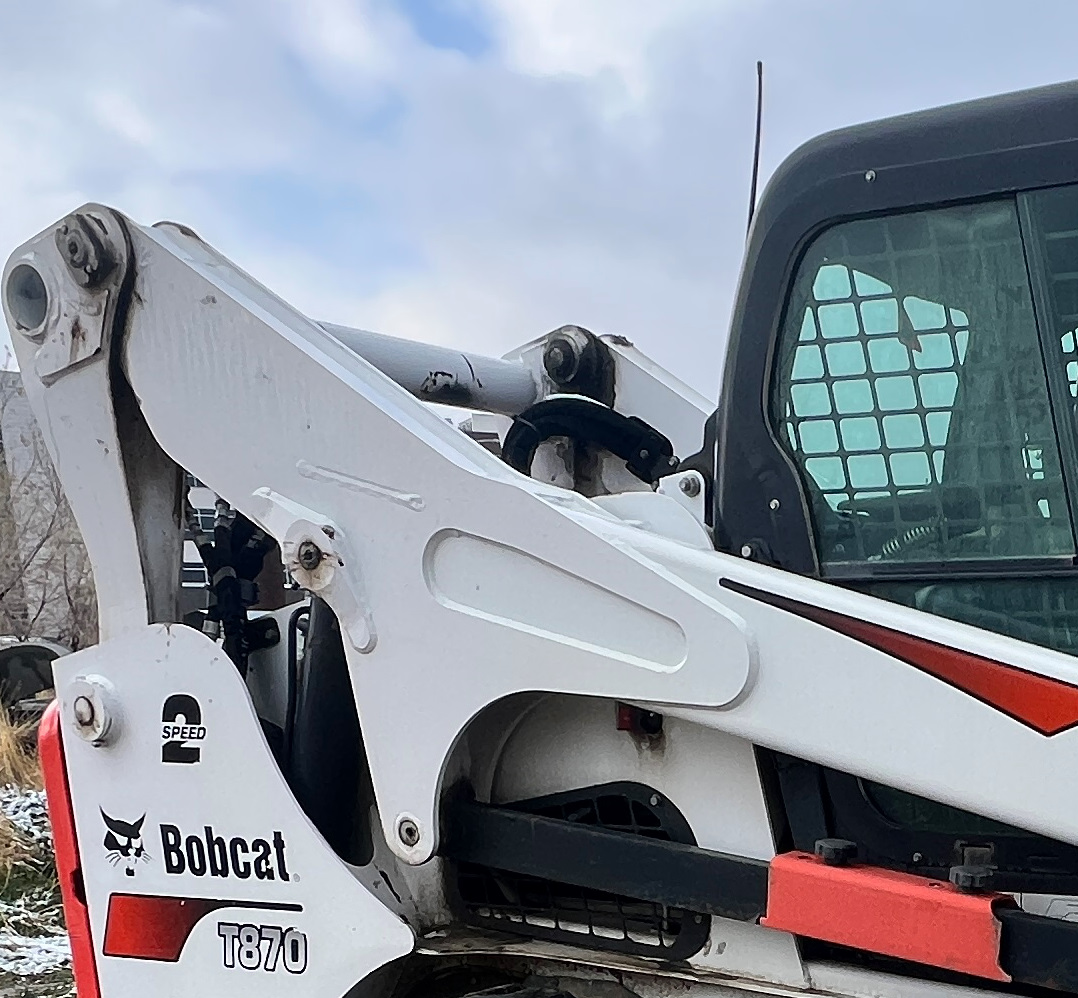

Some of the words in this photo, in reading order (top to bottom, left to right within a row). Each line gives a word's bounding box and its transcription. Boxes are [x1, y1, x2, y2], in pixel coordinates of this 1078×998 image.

[162, 694, 201, 763] 2
[162, 725, 206, 740] SPEED
[160, 824, 290, 881] Bobcat
[217, 922, 307, 974] T870
